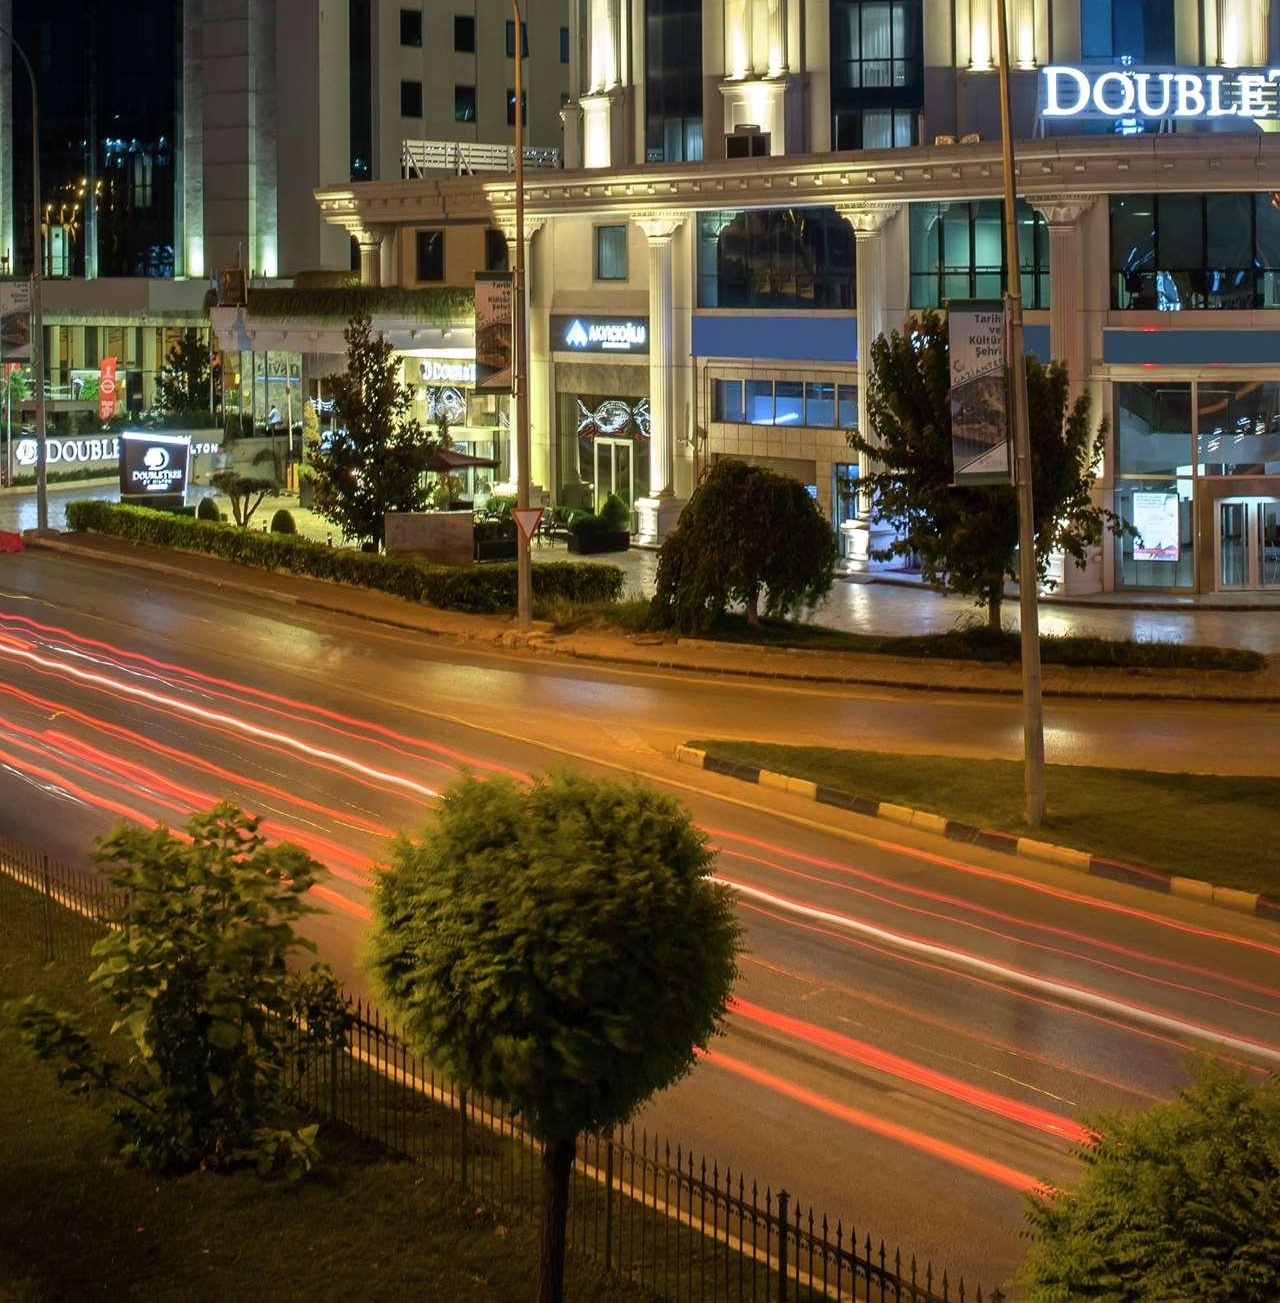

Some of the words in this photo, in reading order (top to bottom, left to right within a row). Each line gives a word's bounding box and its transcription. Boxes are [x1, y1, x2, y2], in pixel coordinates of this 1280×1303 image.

[974, 313, 1001, 323] Tarih
[989, 326, 1001, 334] ve
[969, 335, 1002, 345] Kültür
[190, 443, 218, 455] LTON
